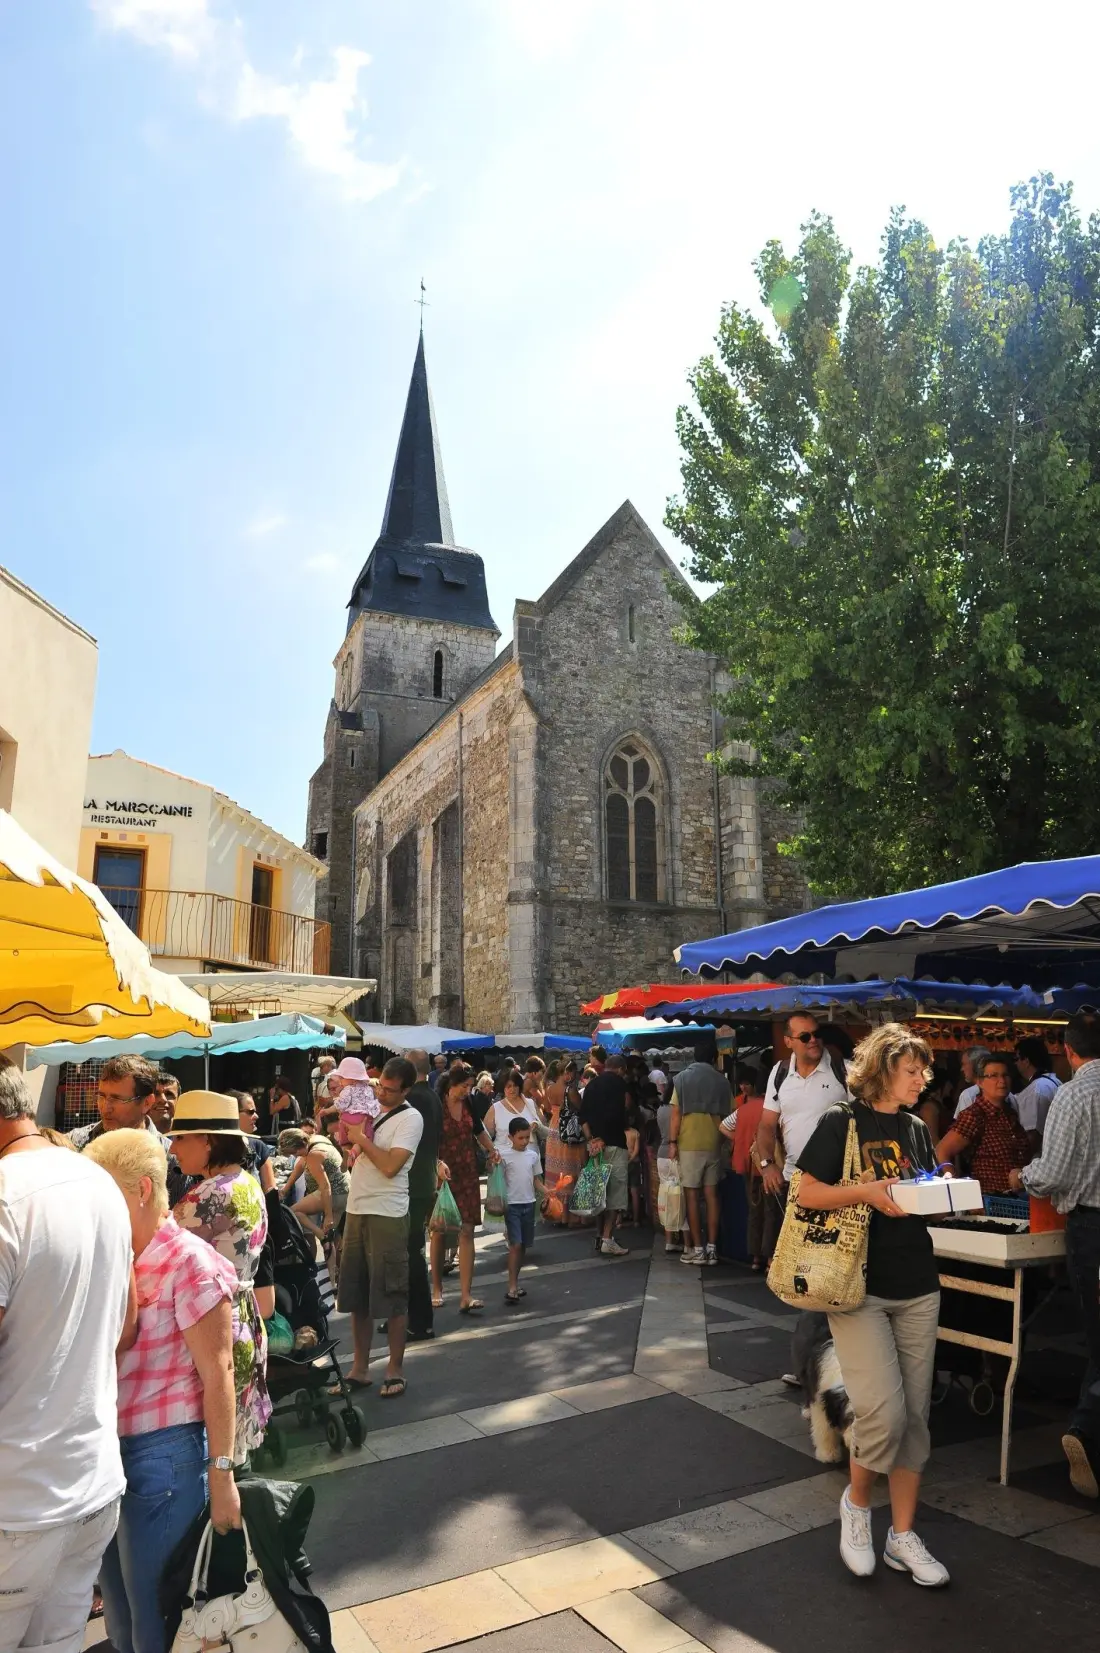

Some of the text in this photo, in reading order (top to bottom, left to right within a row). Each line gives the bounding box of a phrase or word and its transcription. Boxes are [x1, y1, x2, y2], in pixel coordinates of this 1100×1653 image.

[106, 800, 192, 817] MAROCAINE
[91, 814, 157, 827] RESTAURANT
[850, 1210, 866, 1223] Ono
